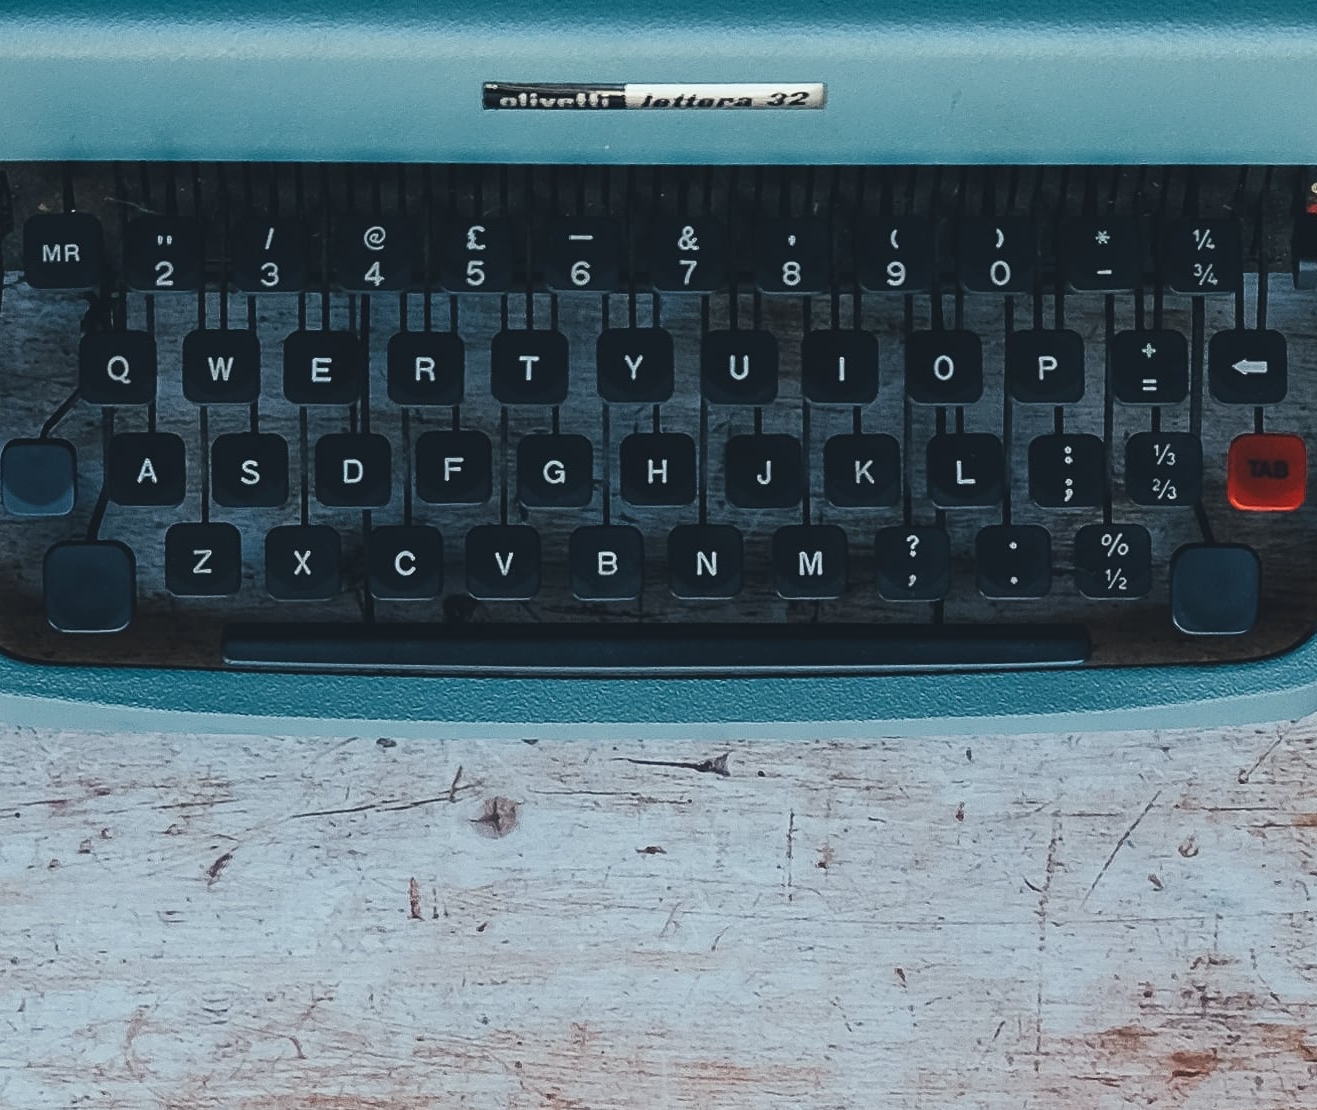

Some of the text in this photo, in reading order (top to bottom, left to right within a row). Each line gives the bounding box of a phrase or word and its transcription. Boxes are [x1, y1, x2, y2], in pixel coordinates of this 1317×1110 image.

[498, 90, 810, 109] olivetti lettera 32
[42, 243, 81, 263] MR
[154, 259, 175, 288] 2
[260, 260, 281, 288] 3
[364, 261, 385, 287] 4
[466, 260, 485, 286] 5
[570, 260, 591, 286] 6
[679, 259, 698, 286] 7
[782, 261, 801, 287] 8
[886, 260, 906, 287] 9
[989, 260, 1011, 287] 0
[106, 354, 1058, 385] Q W E R T Y U I O P
[136, 456, 1289, 485] A S D F G H J K L TAB
[192, 549, 824, 577] Z X C V B N M
